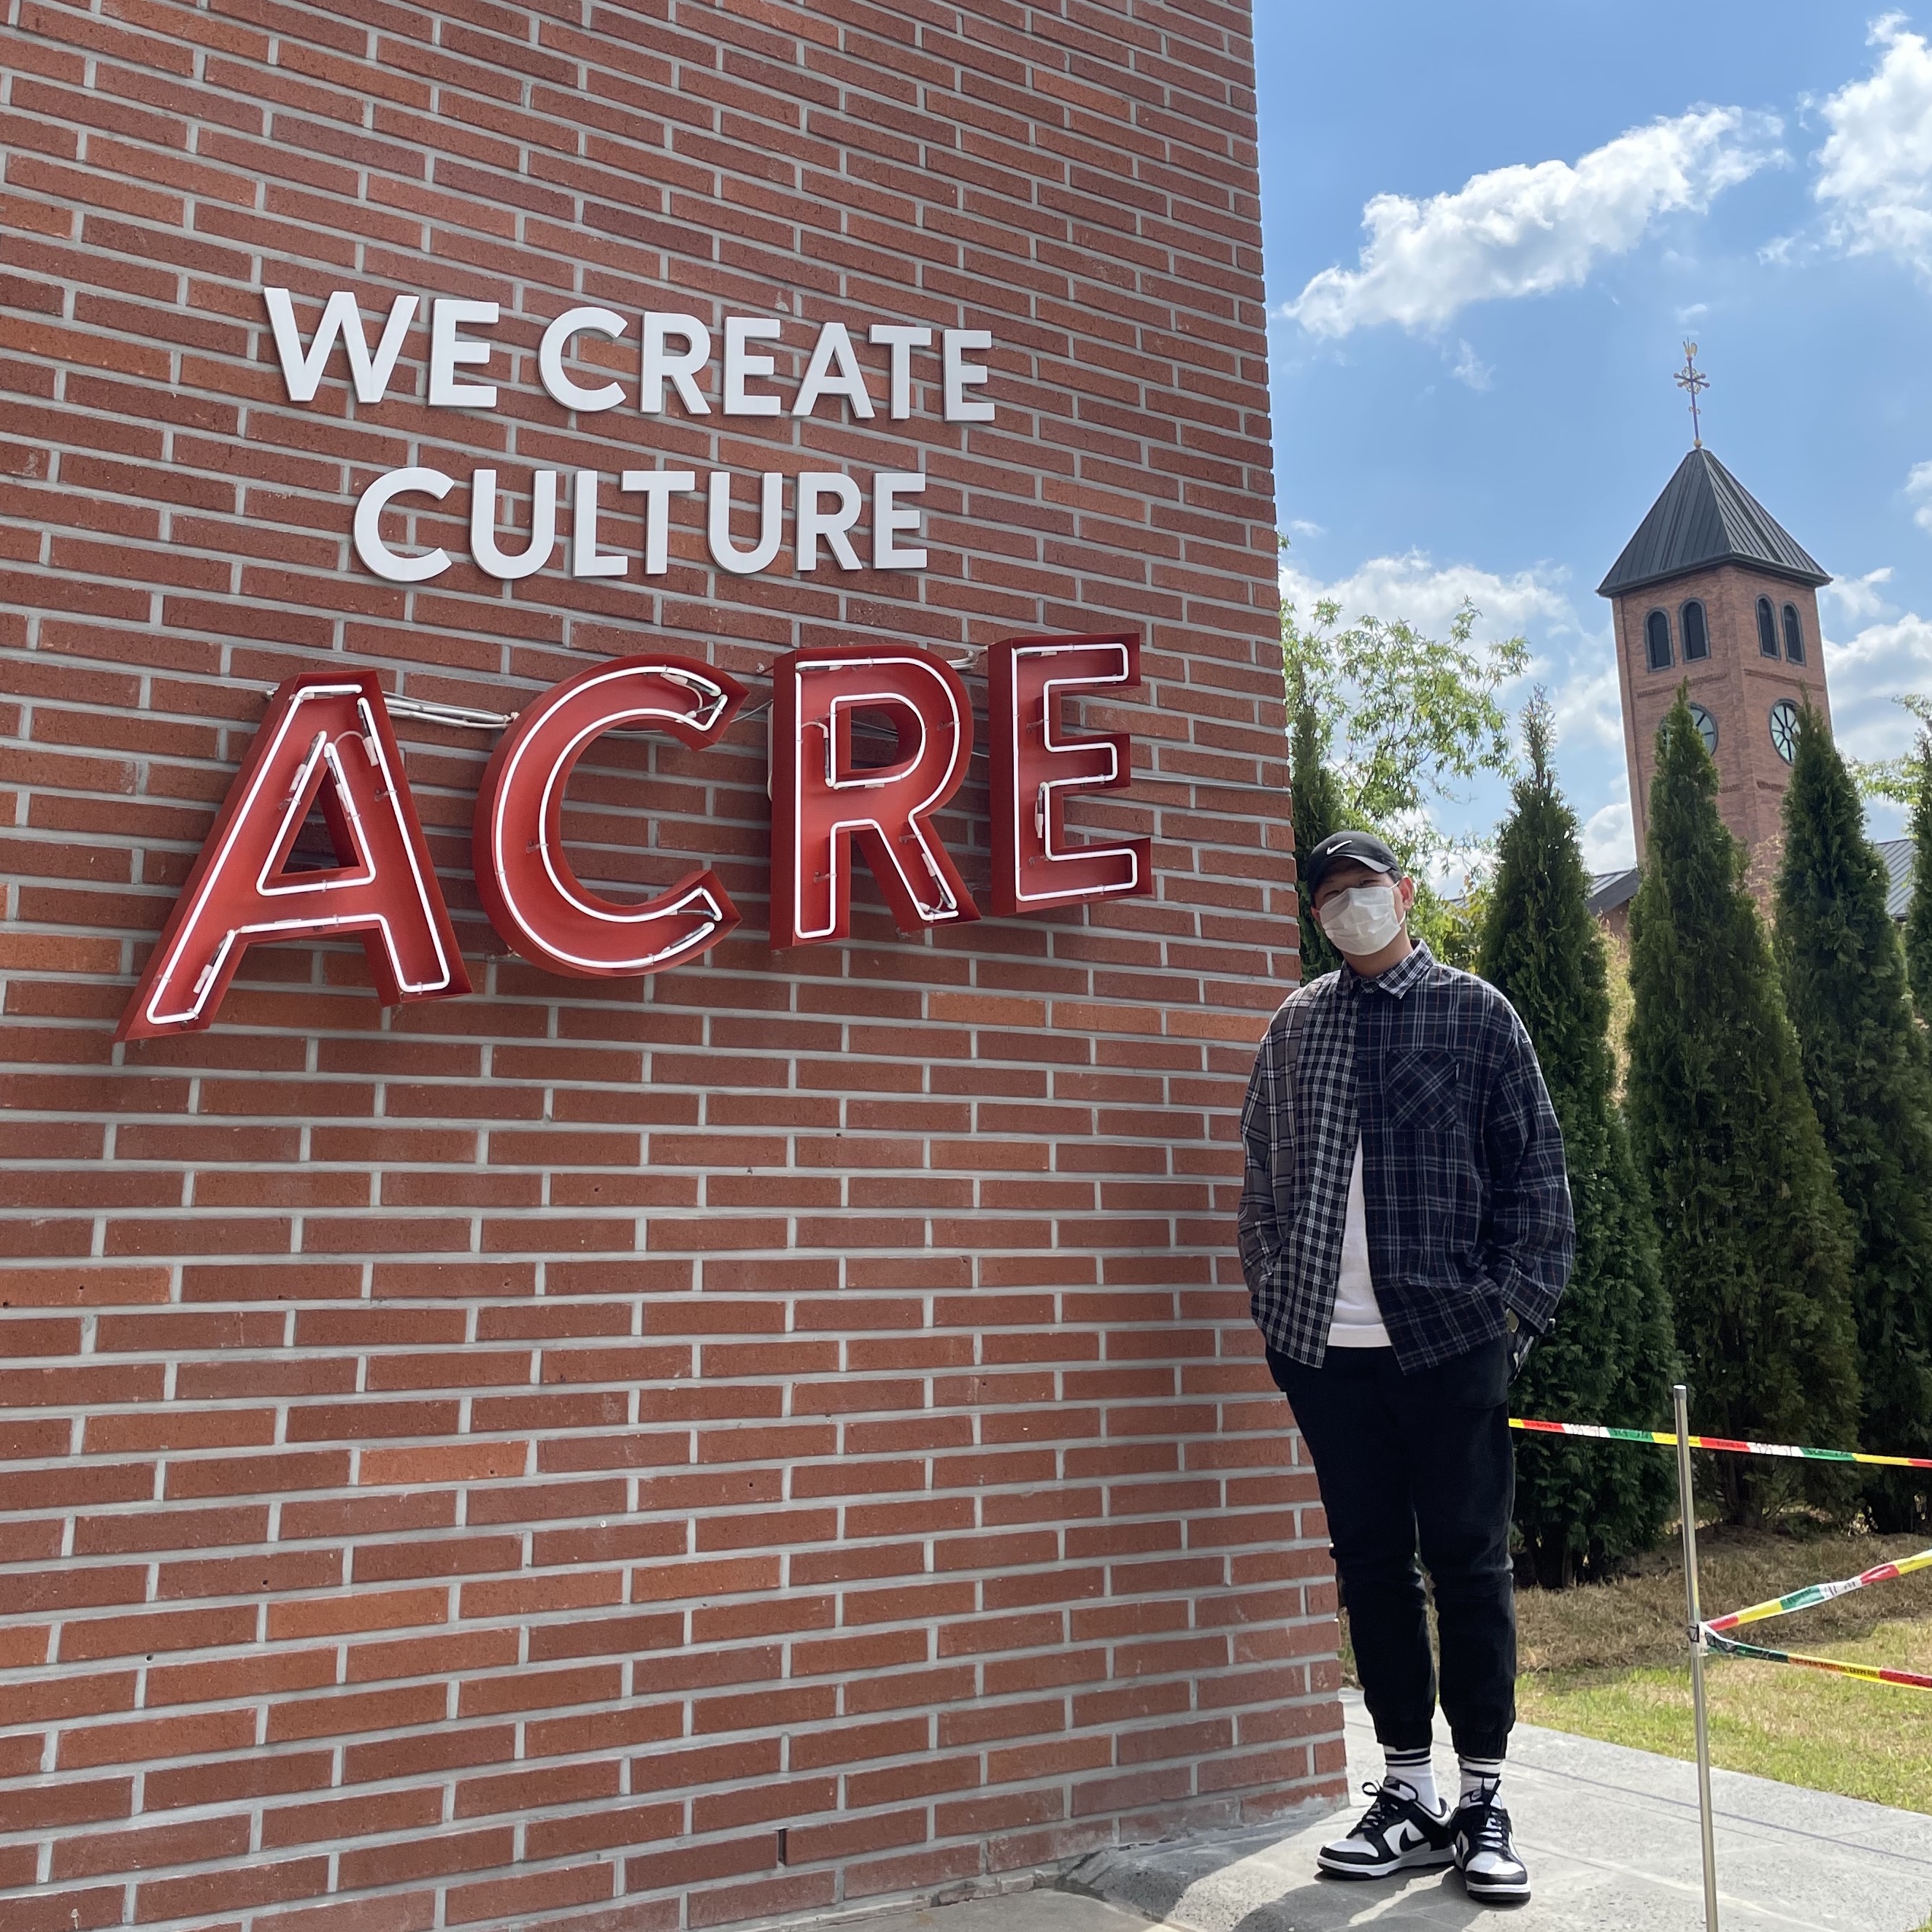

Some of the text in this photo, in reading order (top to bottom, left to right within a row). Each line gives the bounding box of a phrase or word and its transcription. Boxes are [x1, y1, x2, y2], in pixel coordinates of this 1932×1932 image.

[263, 288, 996, 422] WE CREATE
[353, 466, 928, 582] CULTURE
[116, 632, 1152, 1041] ACRE
